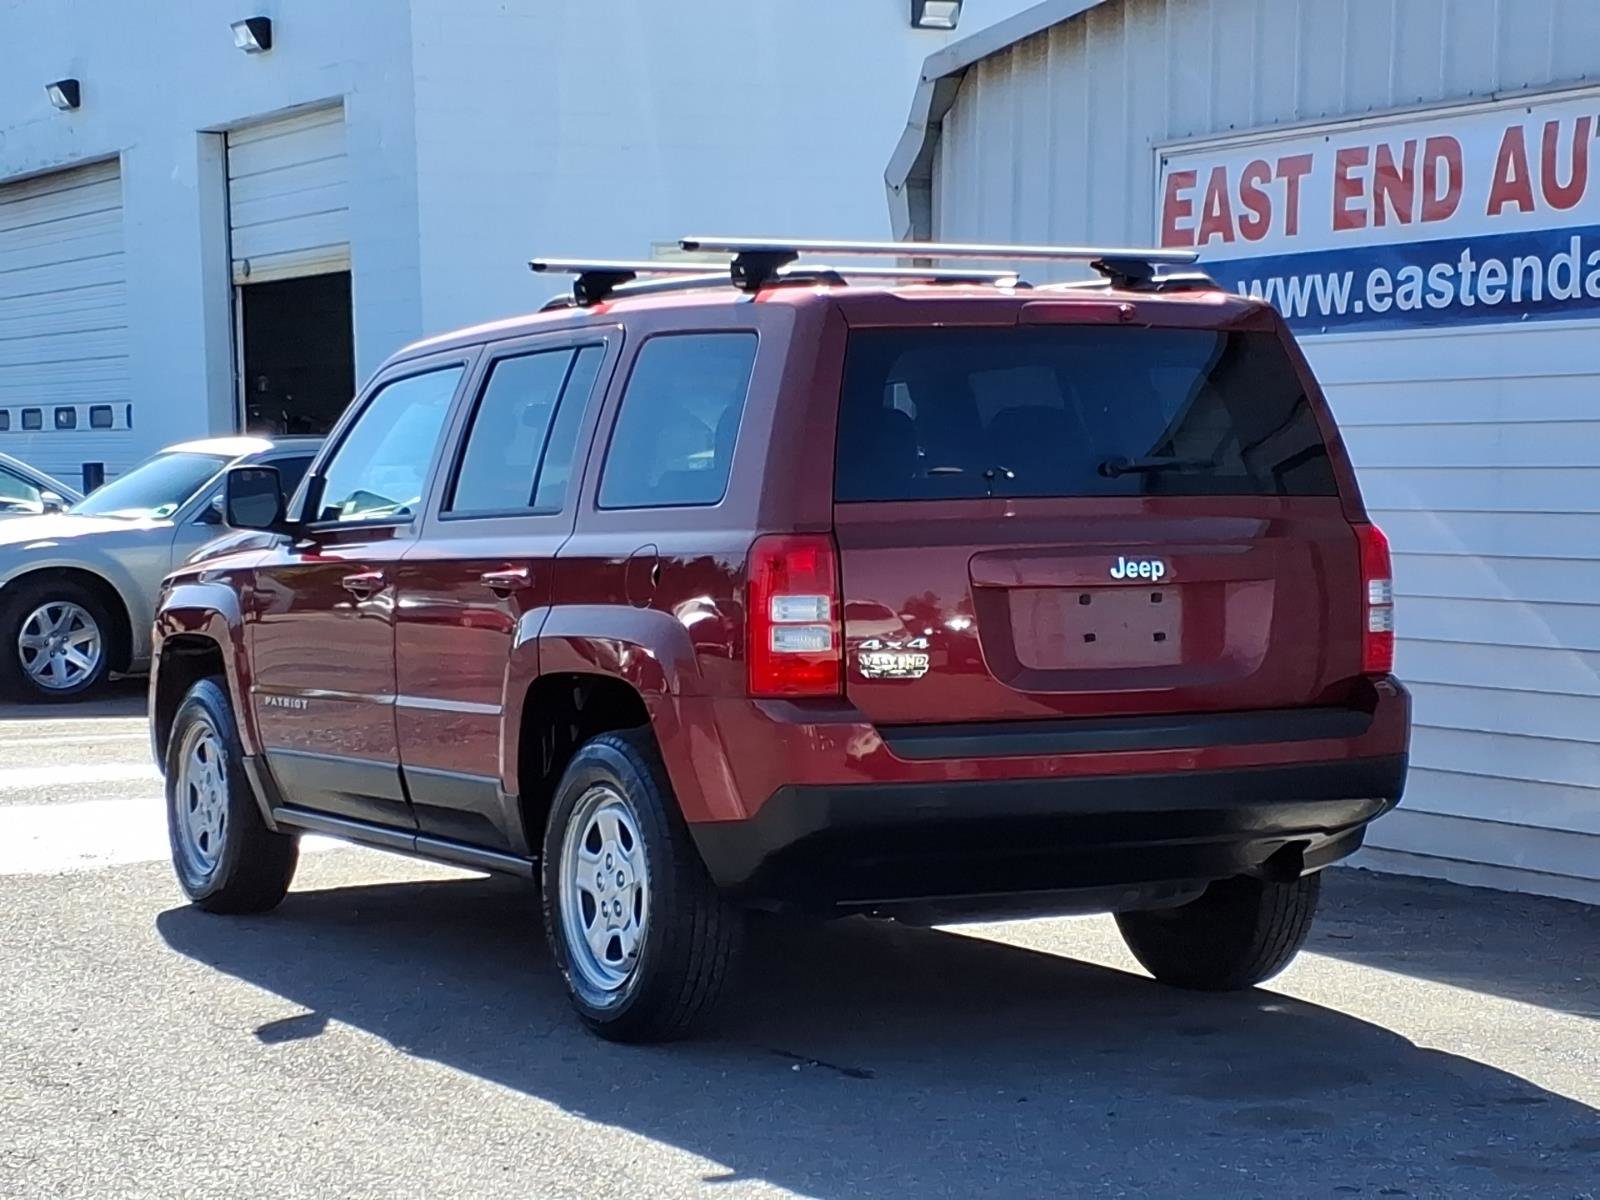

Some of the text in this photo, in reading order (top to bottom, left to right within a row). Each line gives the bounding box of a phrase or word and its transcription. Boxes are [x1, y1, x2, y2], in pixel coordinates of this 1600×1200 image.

[1161, 115, 1600, 248] EAST END AU
[1110, 556, 1165, 582] Jeep
[264, 696, 308, 709] PATRIOT
